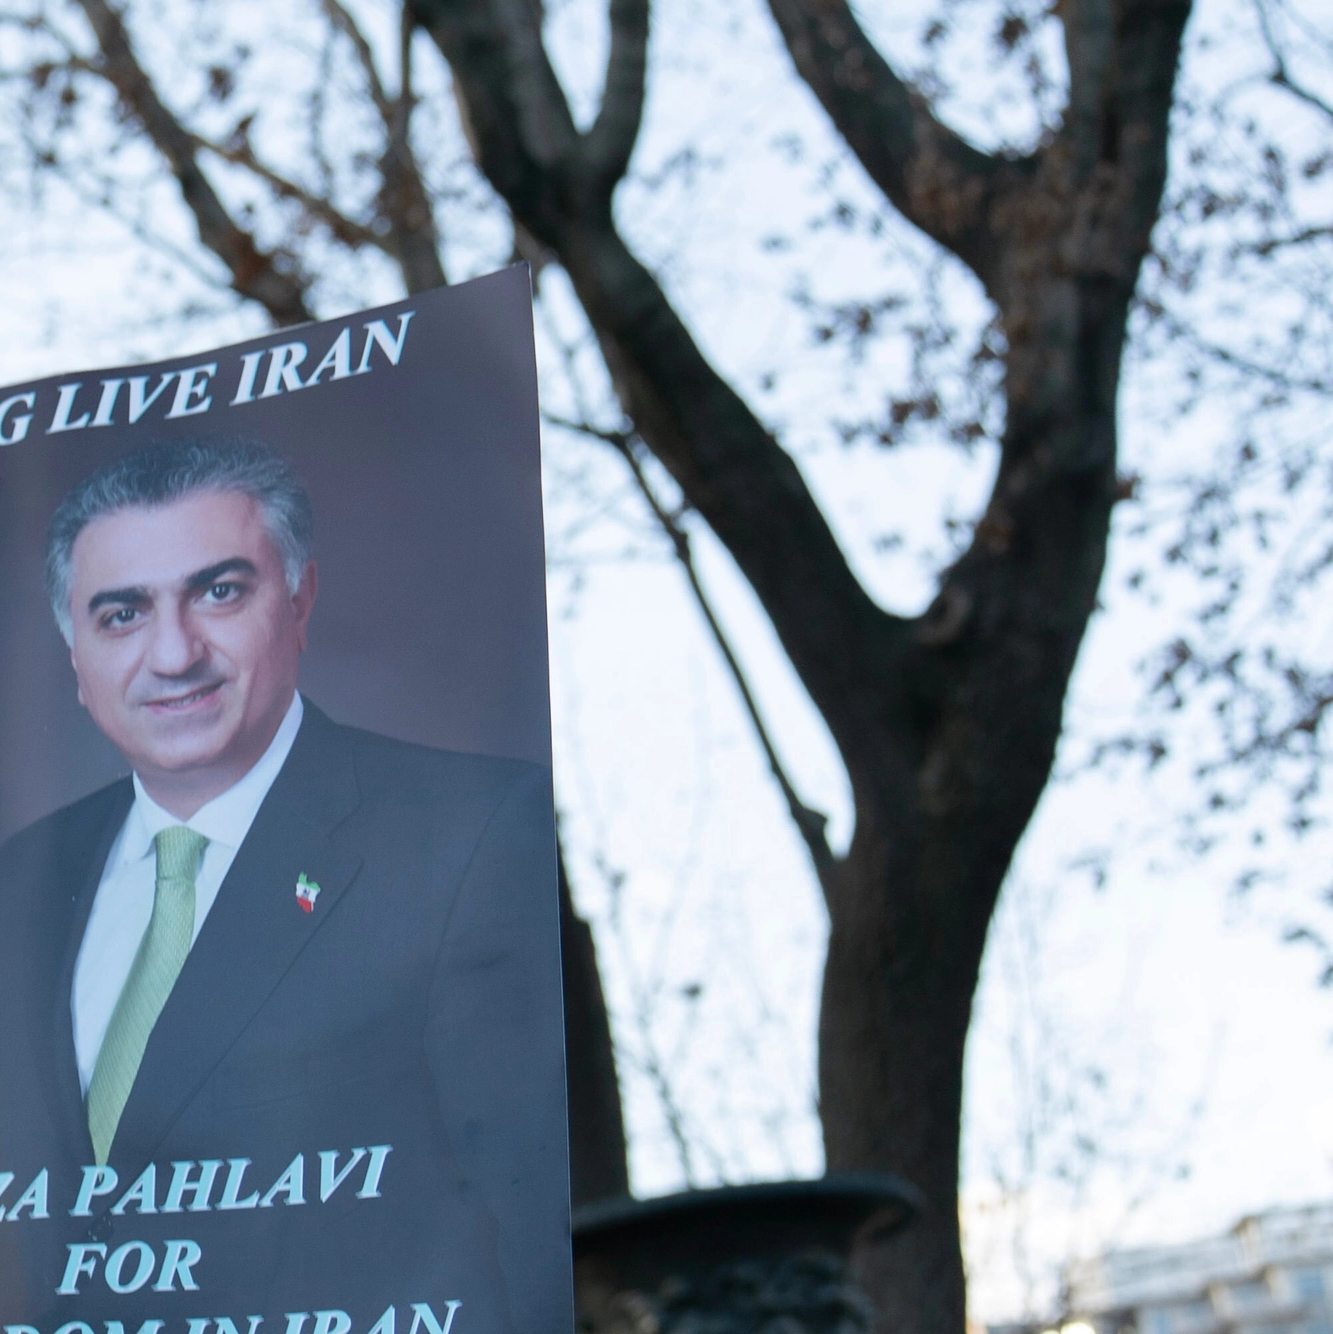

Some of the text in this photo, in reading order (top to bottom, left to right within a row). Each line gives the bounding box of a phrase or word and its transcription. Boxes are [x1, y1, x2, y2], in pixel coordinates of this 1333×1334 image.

[46, 362, 217, 434] LIVE
[230, 311, 415, 405] IRAN
[69, 1144, 393, 1217] PAHLAVI
[55, 1239, 202, 1296] FOR
